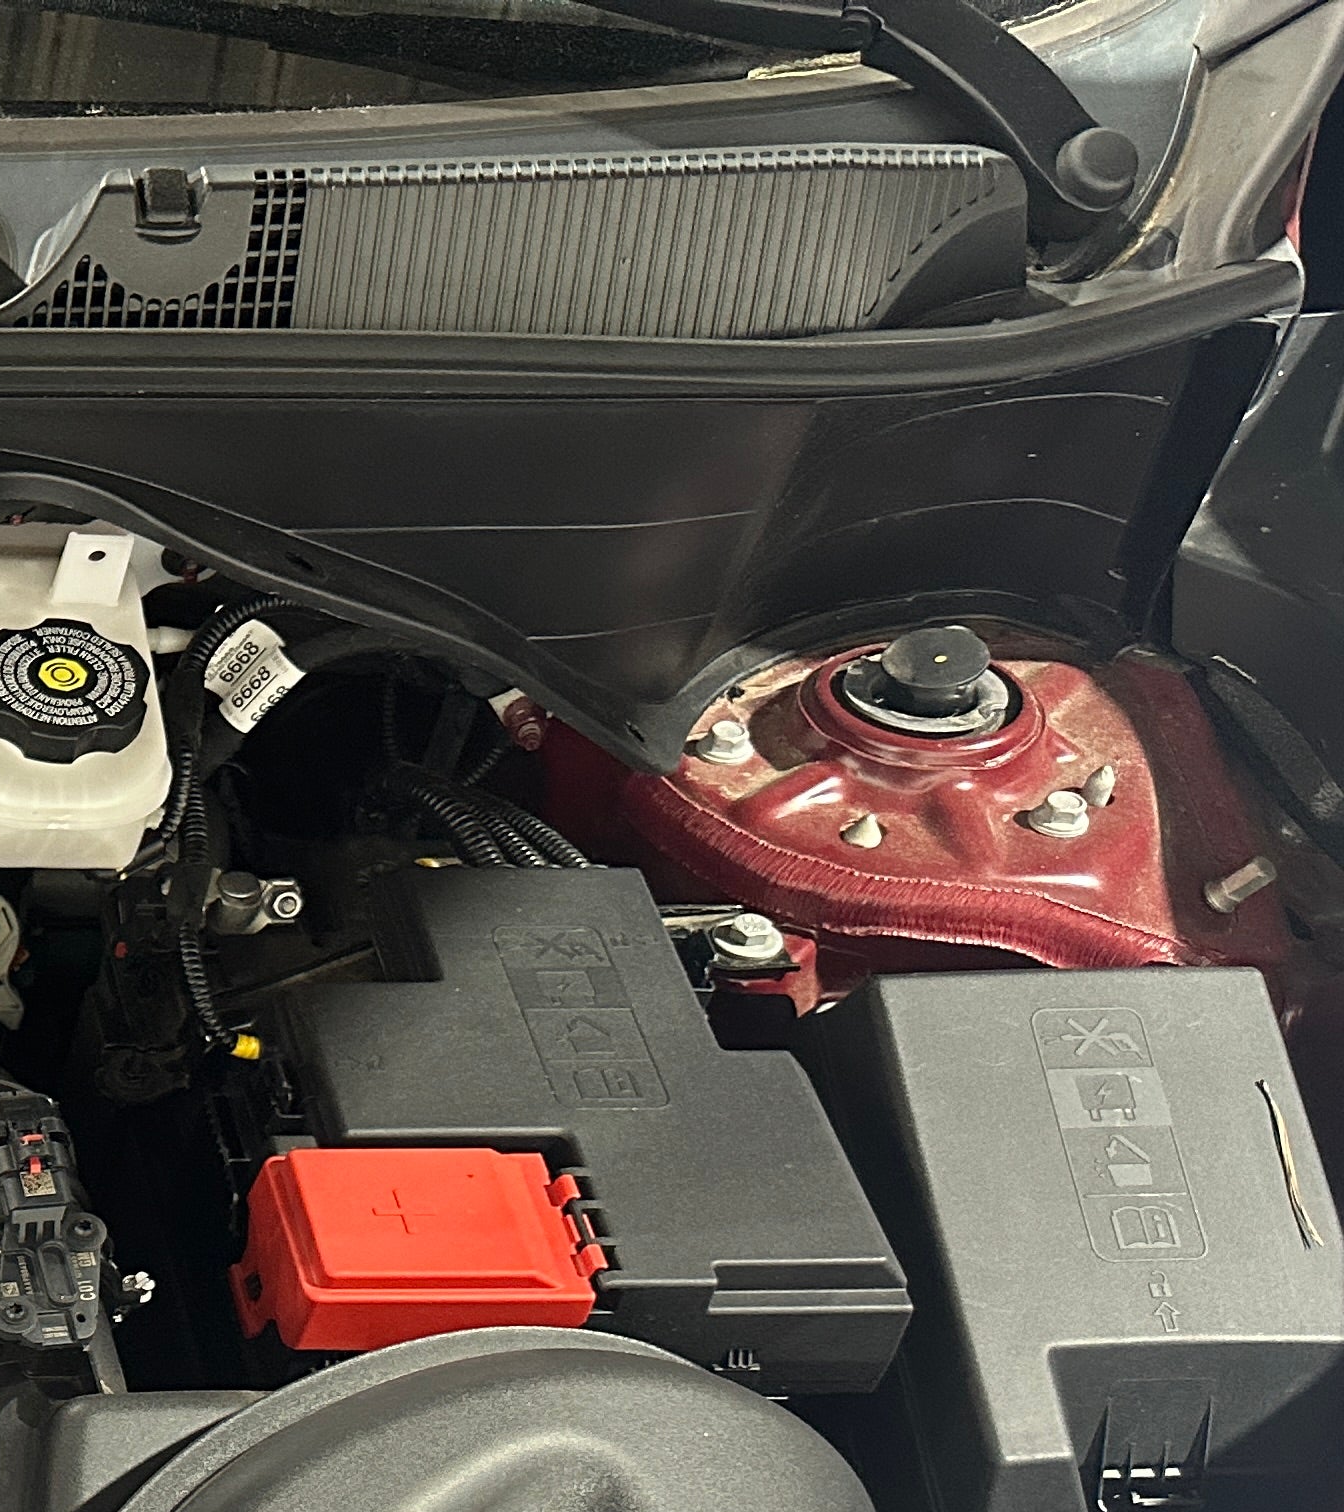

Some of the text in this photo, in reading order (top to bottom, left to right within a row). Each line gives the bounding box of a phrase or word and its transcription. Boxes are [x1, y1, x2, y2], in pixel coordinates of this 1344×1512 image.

[42, 635, 67, 645] ONLY
[46, 644, 81, 656] FILLER
[90, 635, 123, 658] SEALED
[78, 650, 105, 671] CLEAN
[218, 641, 260, 683] 6668
[231, 665, 271, 709] 6668
